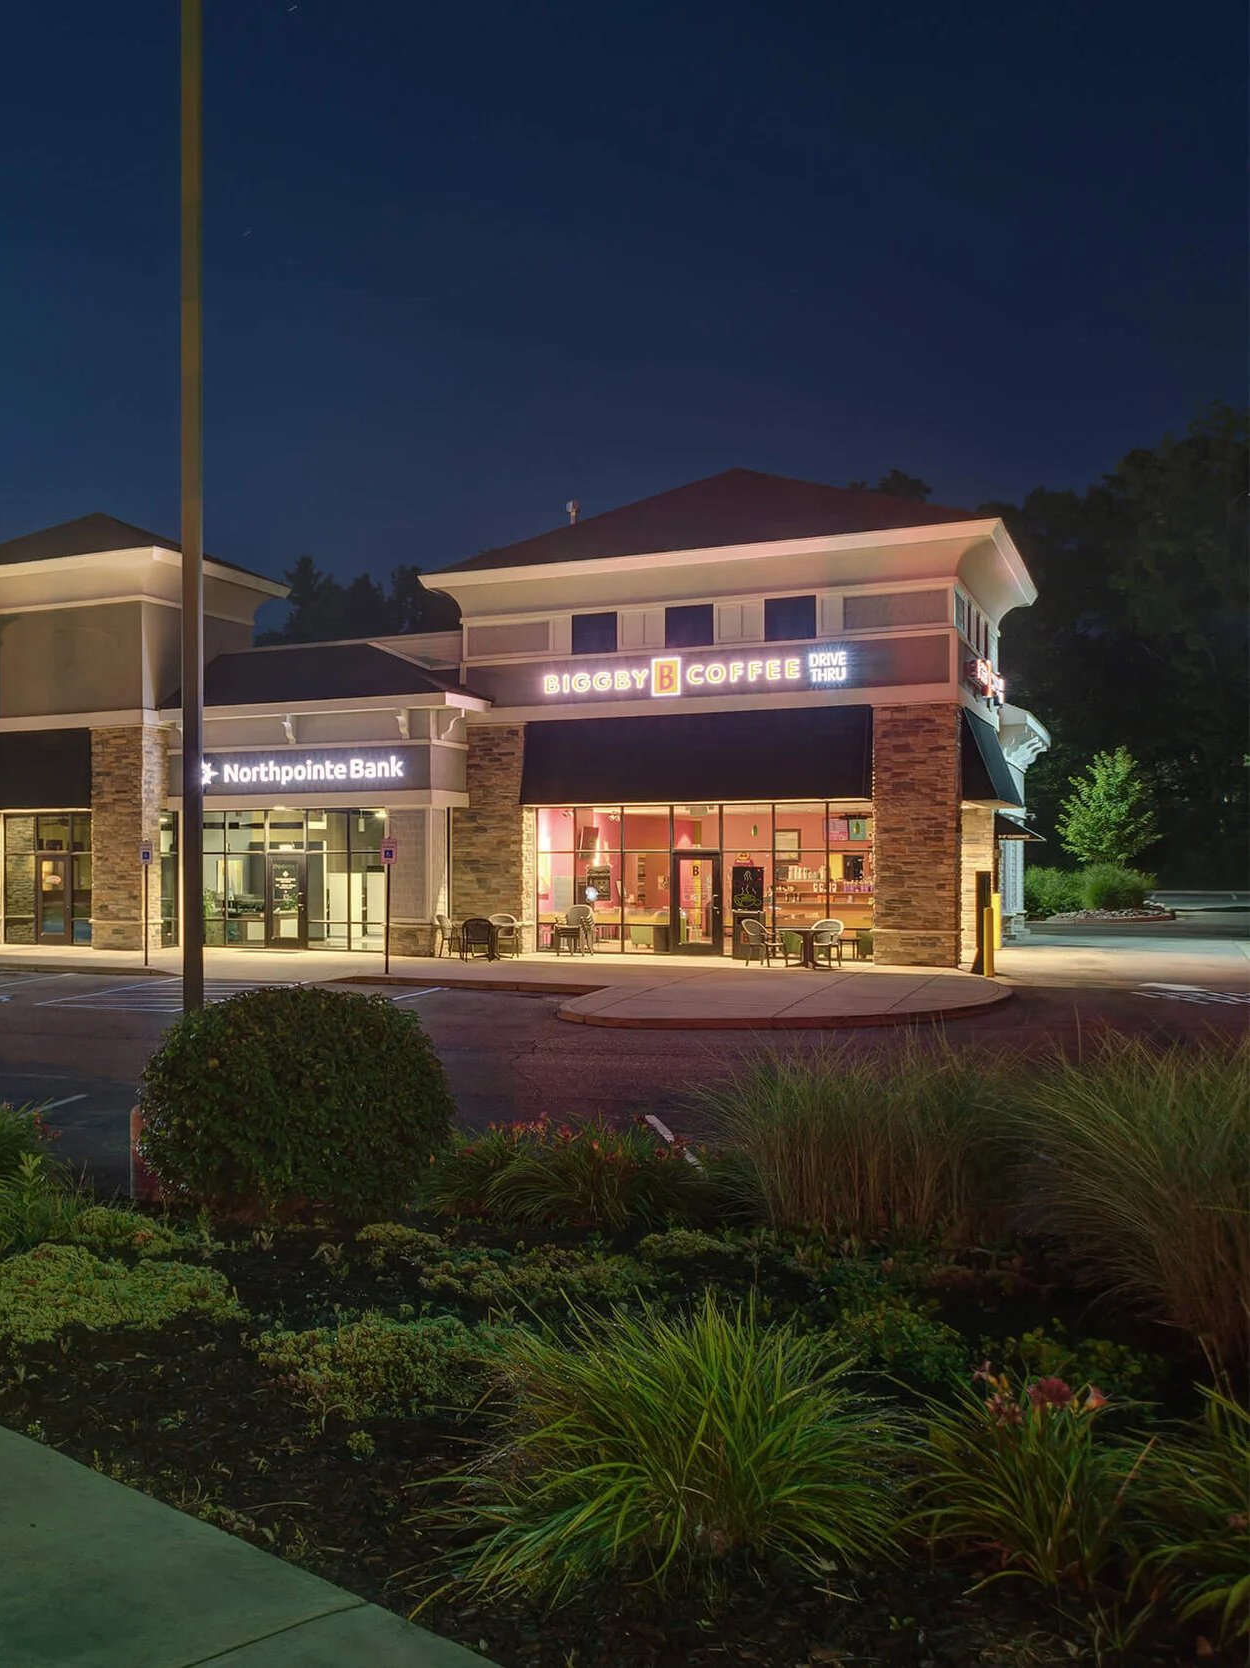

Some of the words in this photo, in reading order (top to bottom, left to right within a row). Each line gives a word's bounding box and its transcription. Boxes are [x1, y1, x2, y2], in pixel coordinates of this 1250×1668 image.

[809, 652, 847, 667] DRIVE
[544, 668, 649, 695] BIGGBY
[658, 664, 675, 691] B
[686, 658, 801, 686] COFFEE
[810, 667, 847, 682] THRU
[223, 760, 348, 785] Northpointe
[349, 756, 404, 779] Bank
[692, 866, 699, 876] B
